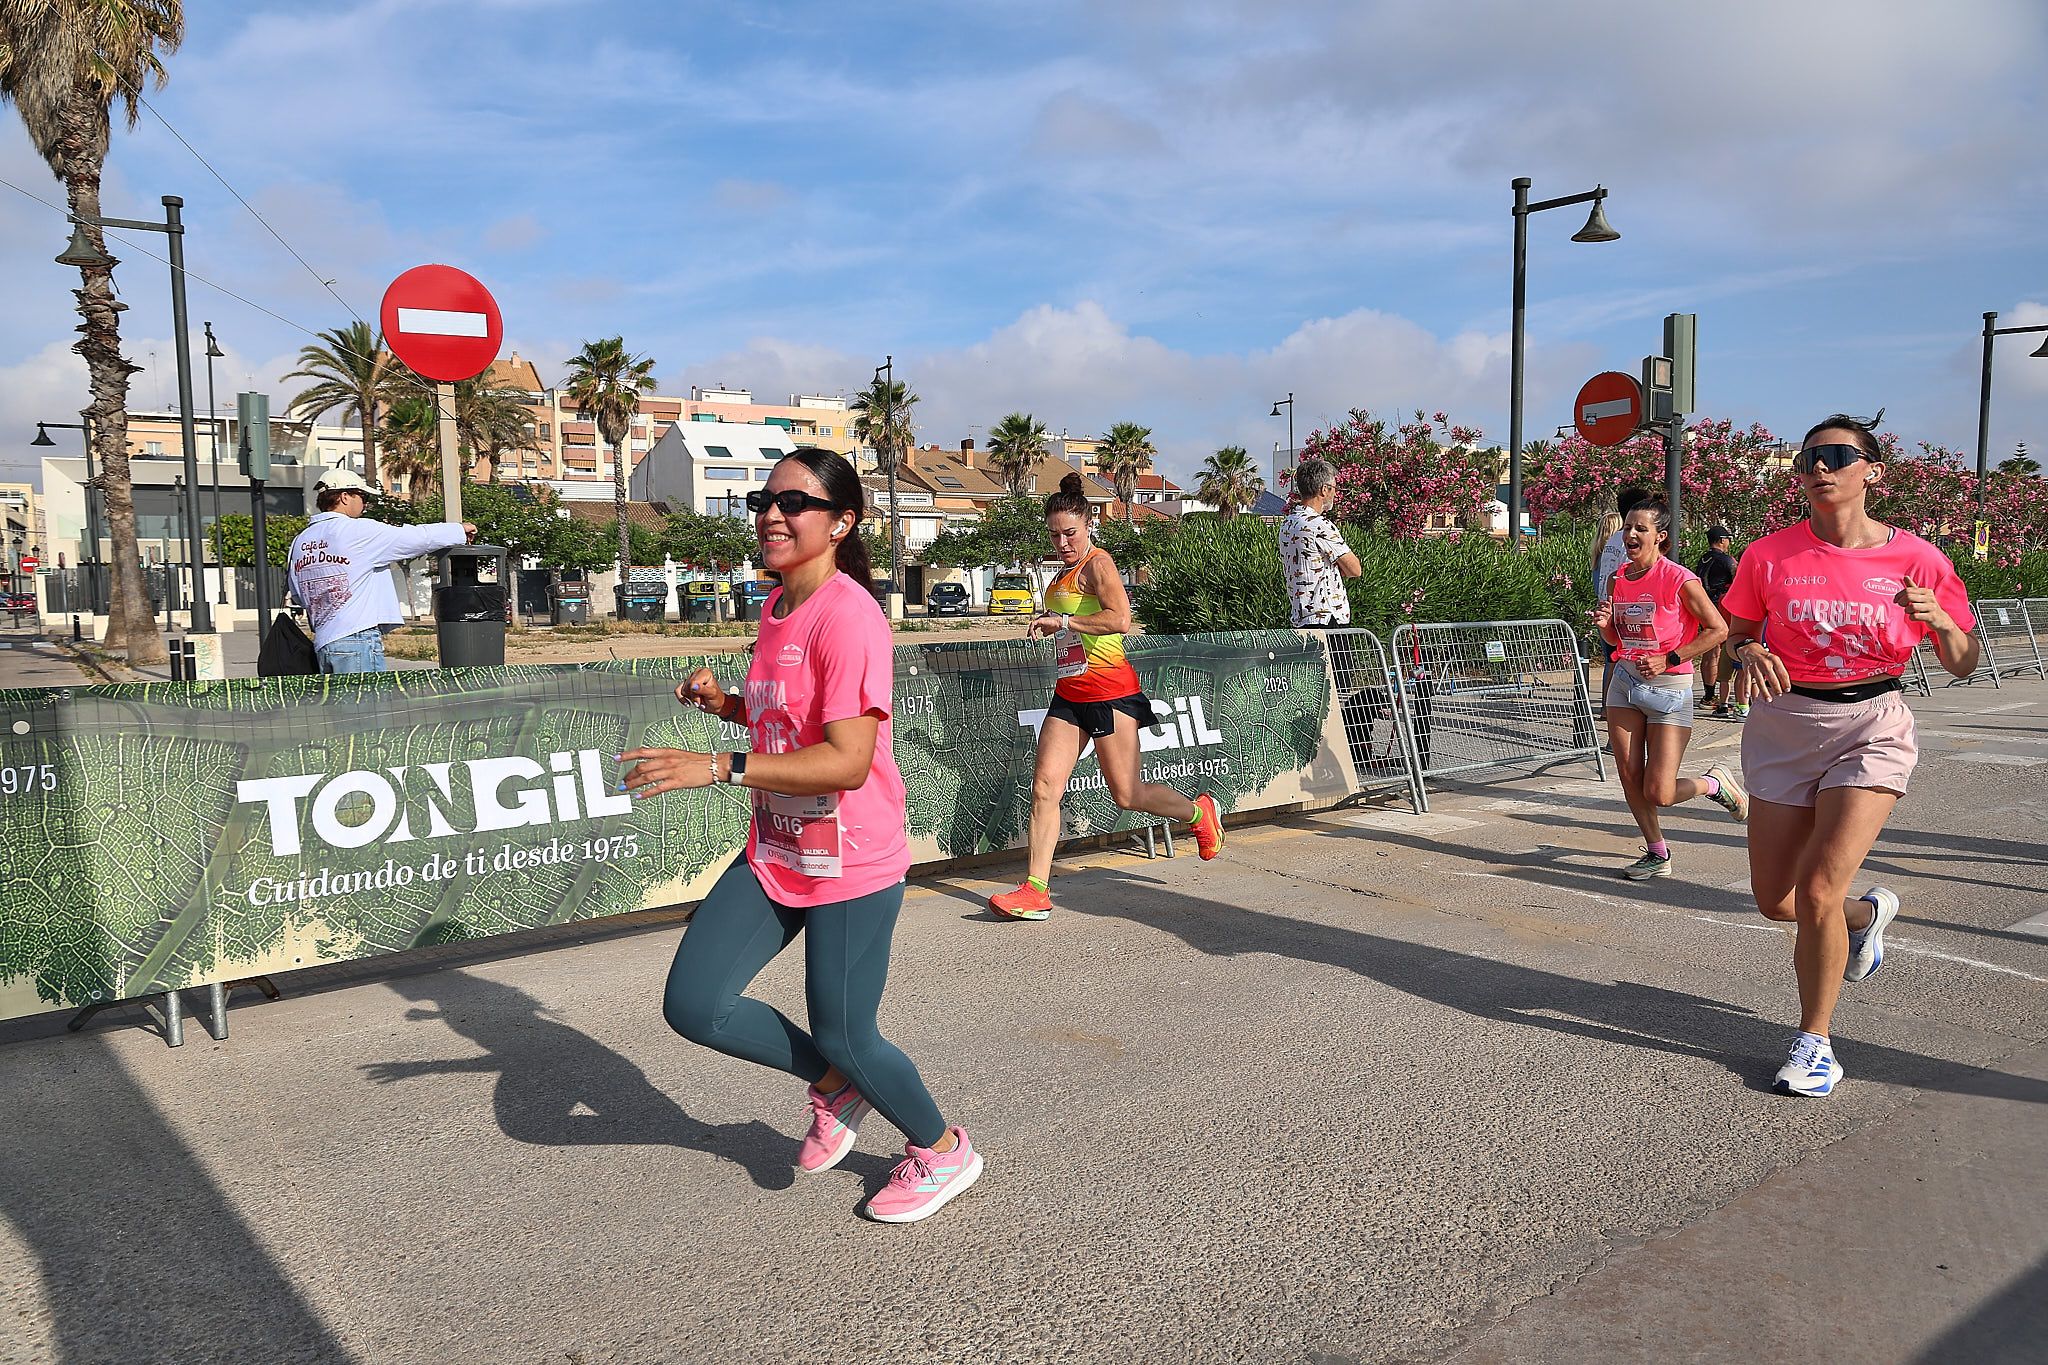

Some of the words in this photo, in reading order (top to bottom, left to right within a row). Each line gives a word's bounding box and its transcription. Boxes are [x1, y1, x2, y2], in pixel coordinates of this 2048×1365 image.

[1784, 576, 1827, 586] OYSHO
[1627, 624, 1641, 632] 016
[1264, 676, 1289, 692] 2026
[745, 680, 788, 711] RRERA
[900, 695, 934, 715] 1975
[720, 720, 751, 740] 202
[0, 764, 57, 794] 975
[1152, 759, 1195, 781] desde
[1198, 757, 1230, 777] 1975
[773, 814, 804, 835] 016
[248, 859, 413, 907] Cuidando
[421, 853, 458, 882] de
[464, 848, 487, 876] ti
[493, 838, 574, 872] desde
[581, 834, 639, 863] 1975
